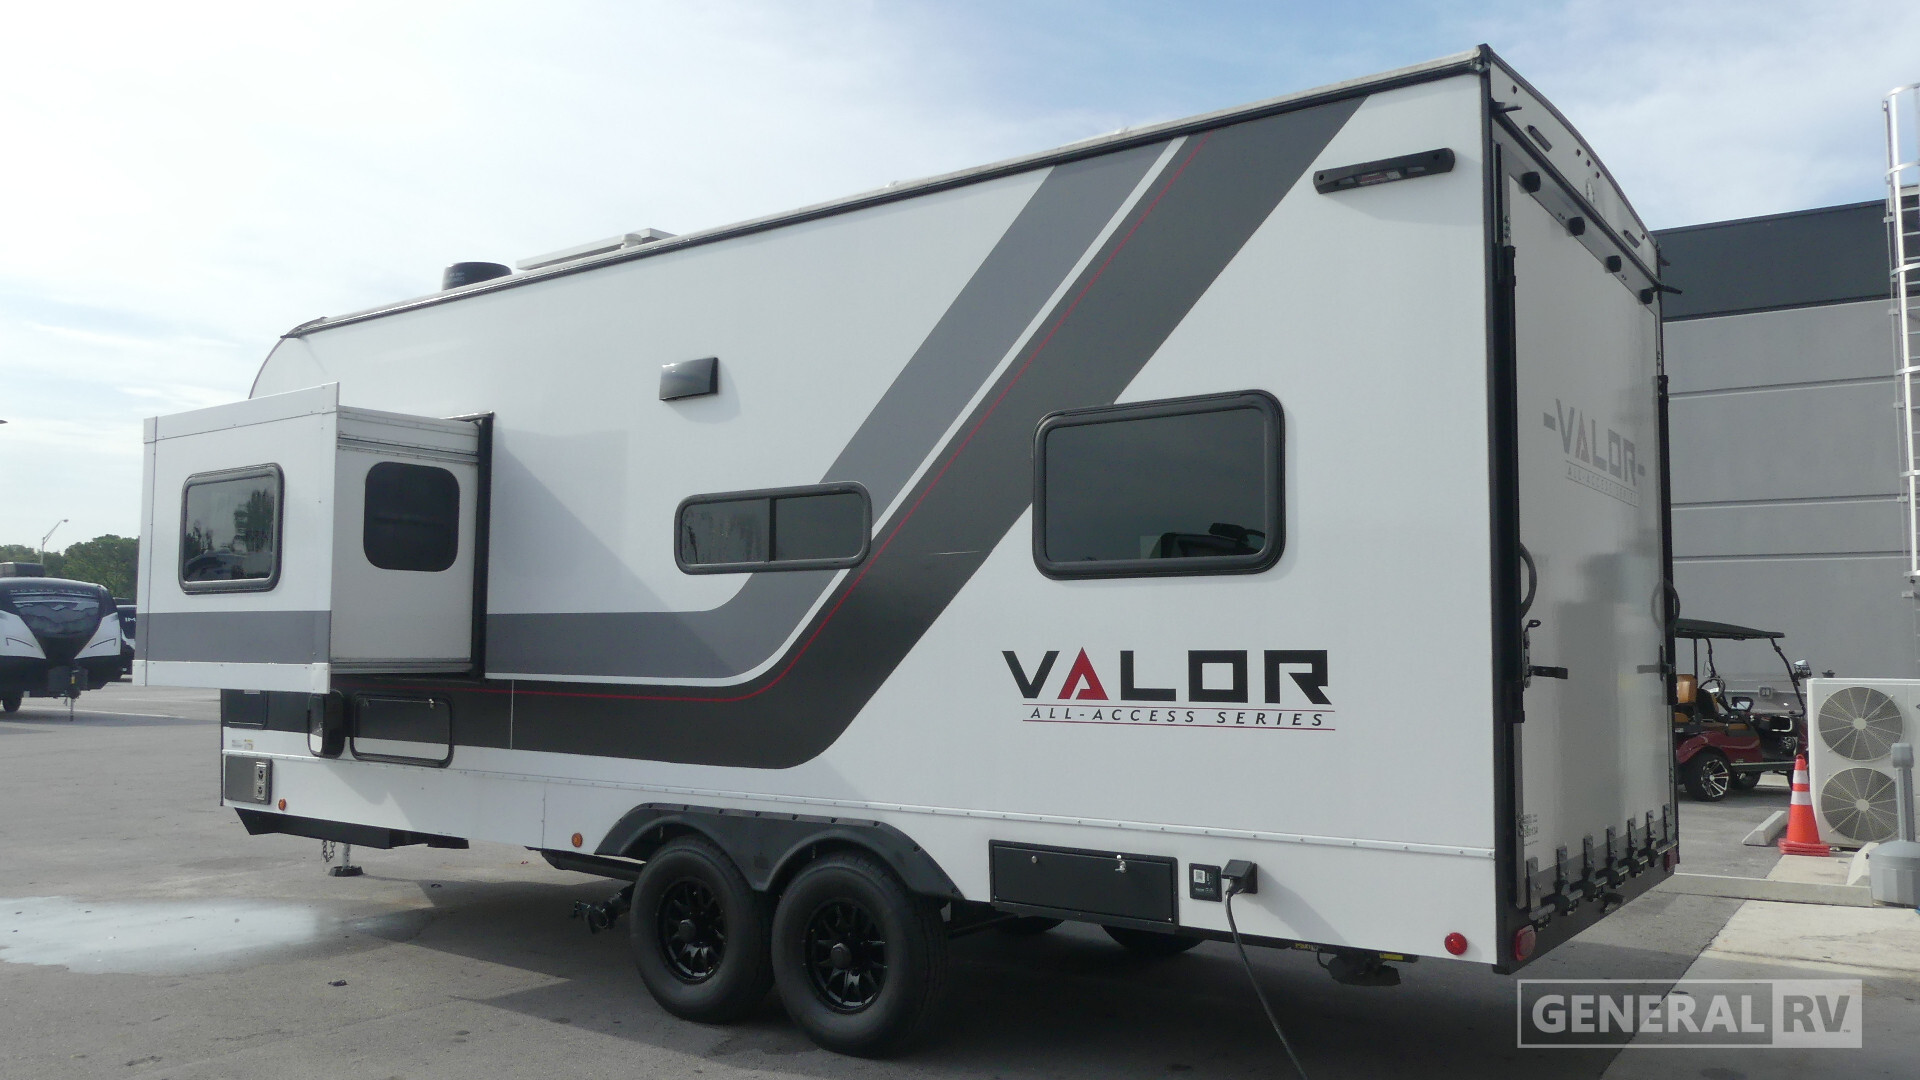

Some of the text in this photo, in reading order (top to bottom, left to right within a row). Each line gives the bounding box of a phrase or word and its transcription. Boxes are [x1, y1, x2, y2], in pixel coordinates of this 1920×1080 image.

[1001, 647, 1333, 705] VALOR
[1030, 707, 1325, 727] ALL-ACCESS SERIES
